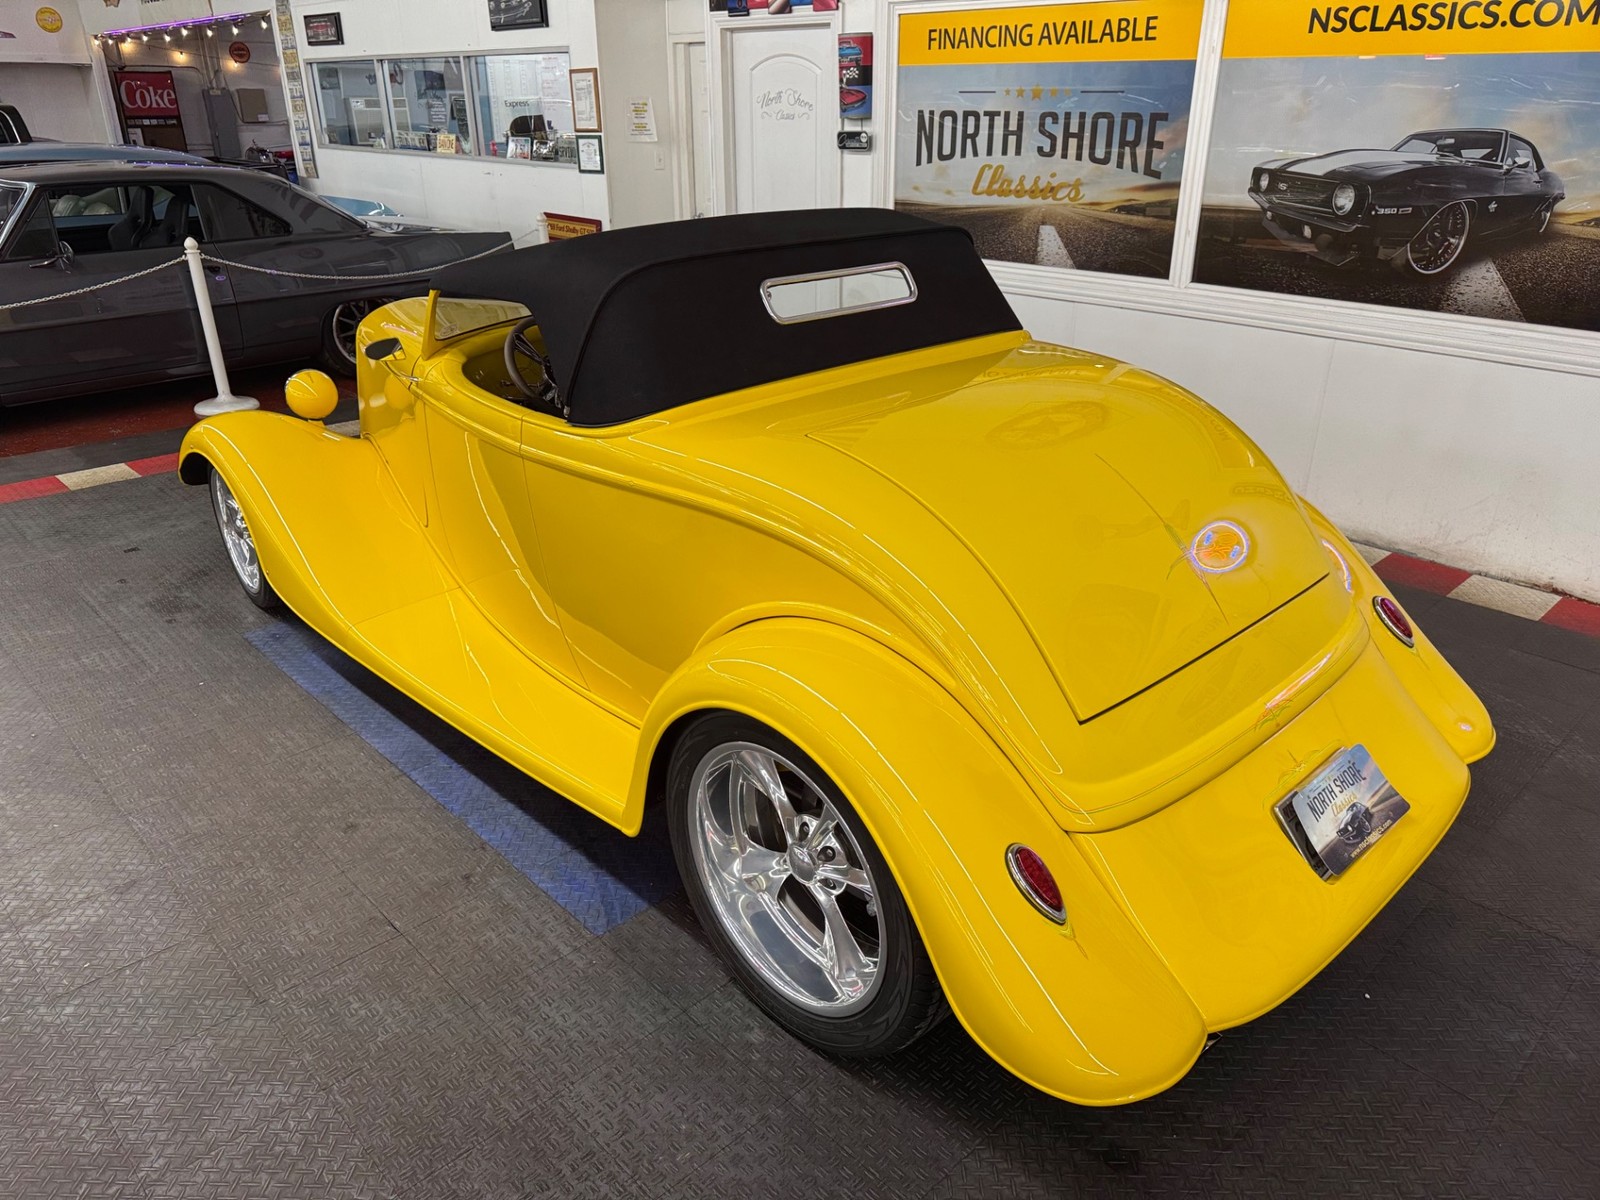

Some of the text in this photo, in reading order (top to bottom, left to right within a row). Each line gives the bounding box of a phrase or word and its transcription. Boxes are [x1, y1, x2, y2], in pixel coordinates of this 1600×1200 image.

[927, 15, 1159, 51] FINANCING AVAILABLE
[1308, 0, 1600, 33] NSCLASSICS.COM
[120, 80, 177, 109] Coke
[504, 100, 530, 109] Express
[756, 87, 813, 111] North Shore
[916, 109, 1169, 180] NORTH SHORE
[972, 163, 1087, 203] Classics
[1306, 783, 1338, 823] NORTH
[1333, 761, 1367, 794] SHORE
